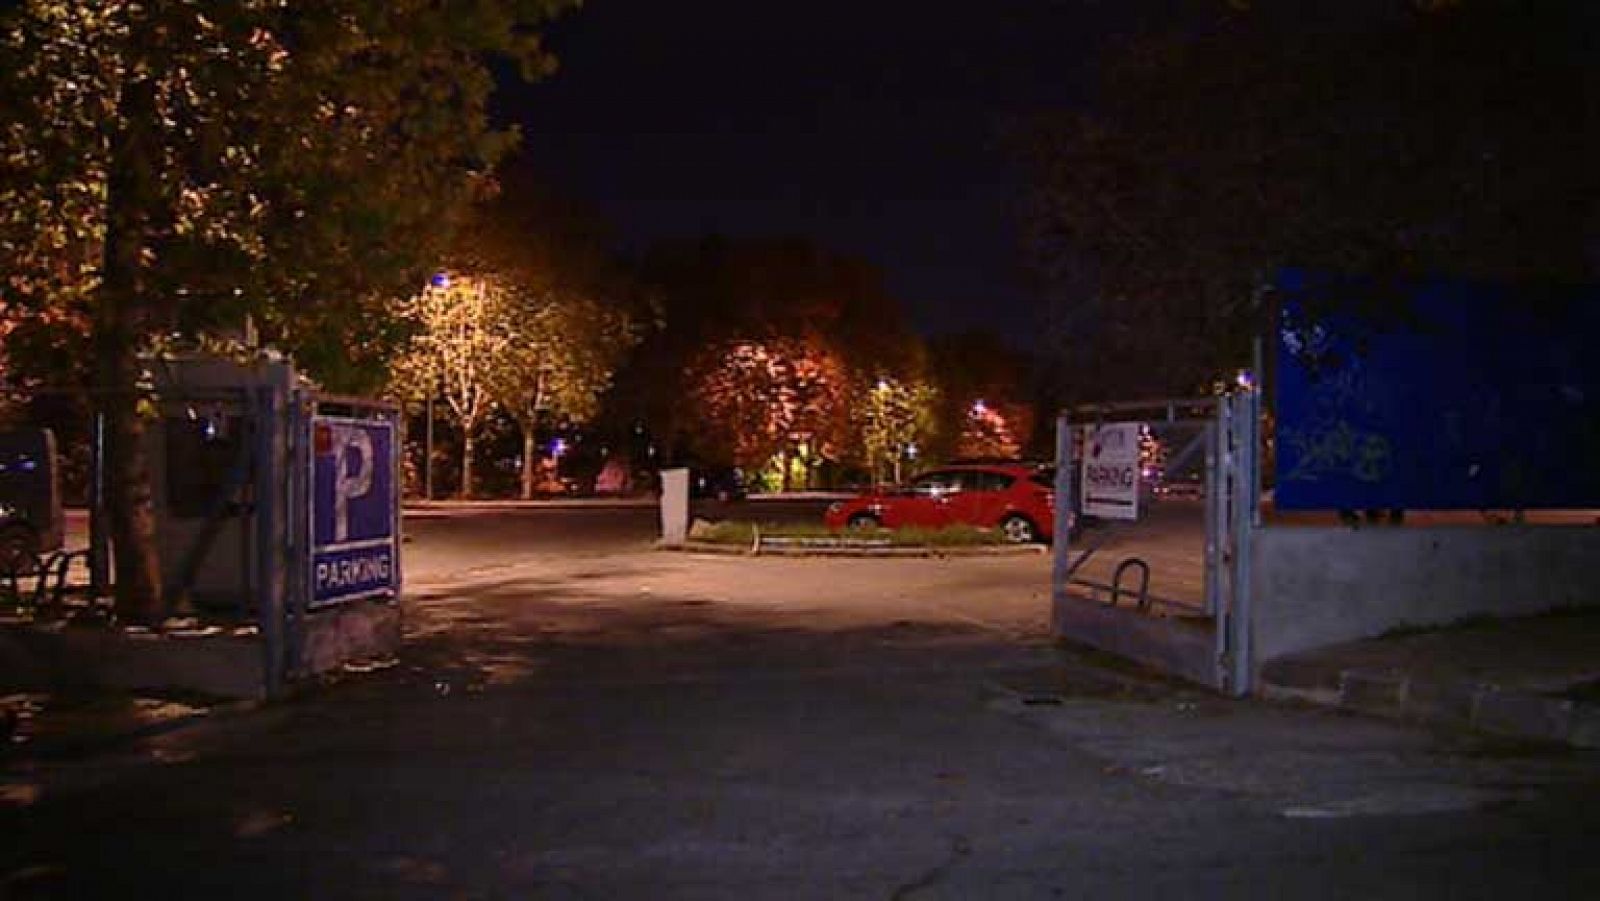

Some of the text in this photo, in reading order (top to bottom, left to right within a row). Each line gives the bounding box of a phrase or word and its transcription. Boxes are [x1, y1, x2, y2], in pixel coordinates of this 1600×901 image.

[333, 424, 373, 542] P
[1087, 464, 1132, 487] PARKING
[316, 555, 390, 590] PARKING
